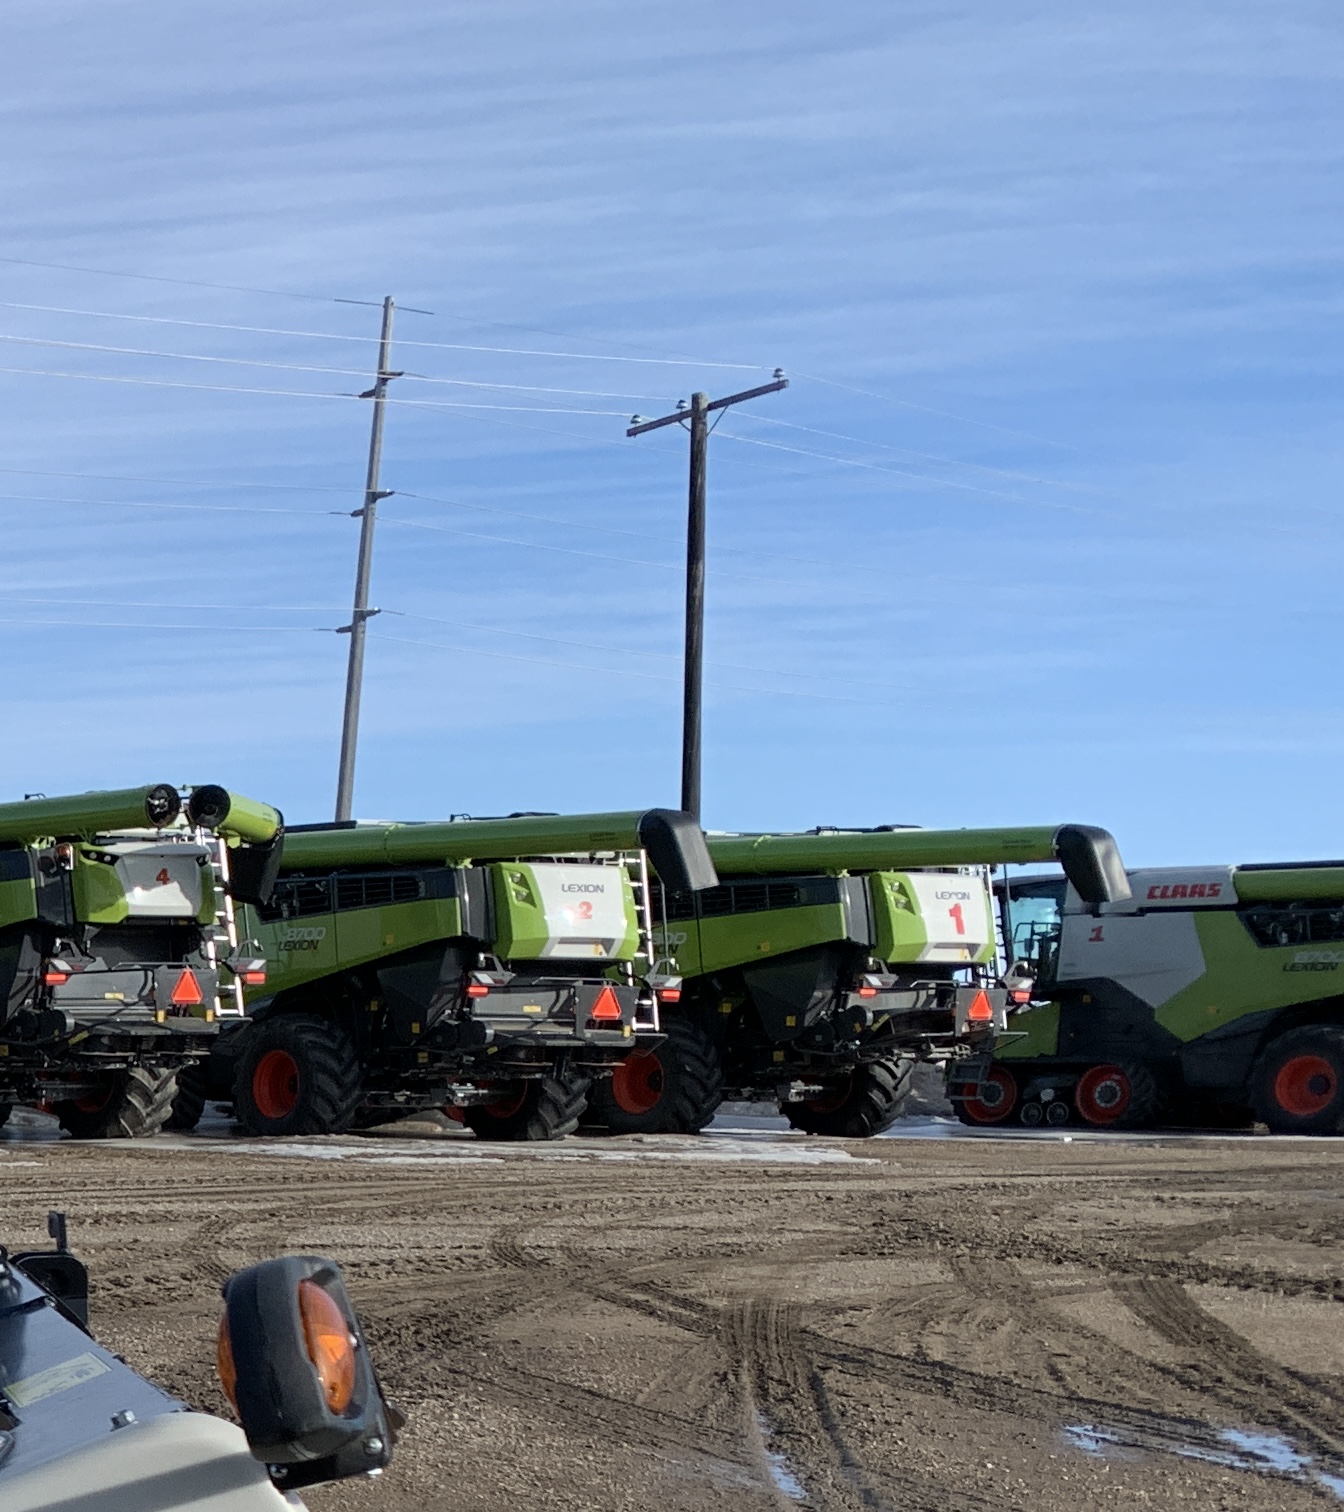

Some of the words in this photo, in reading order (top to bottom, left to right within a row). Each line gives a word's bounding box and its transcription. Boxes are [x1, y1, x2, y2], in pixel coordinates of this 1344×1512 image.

[155, 867, 170, 885] 4
[561, 883, 604, 893] LEXION
[1146, 882, 1223, 899] CLAAS
[948, 903, 965, 935] 1
[287, 927, 326, 941] 8700
[1088, 925, 1105, 942] 1
[278, 939, 319, 951] LEXION
[1282, 962, 1339, 972] LEXION
